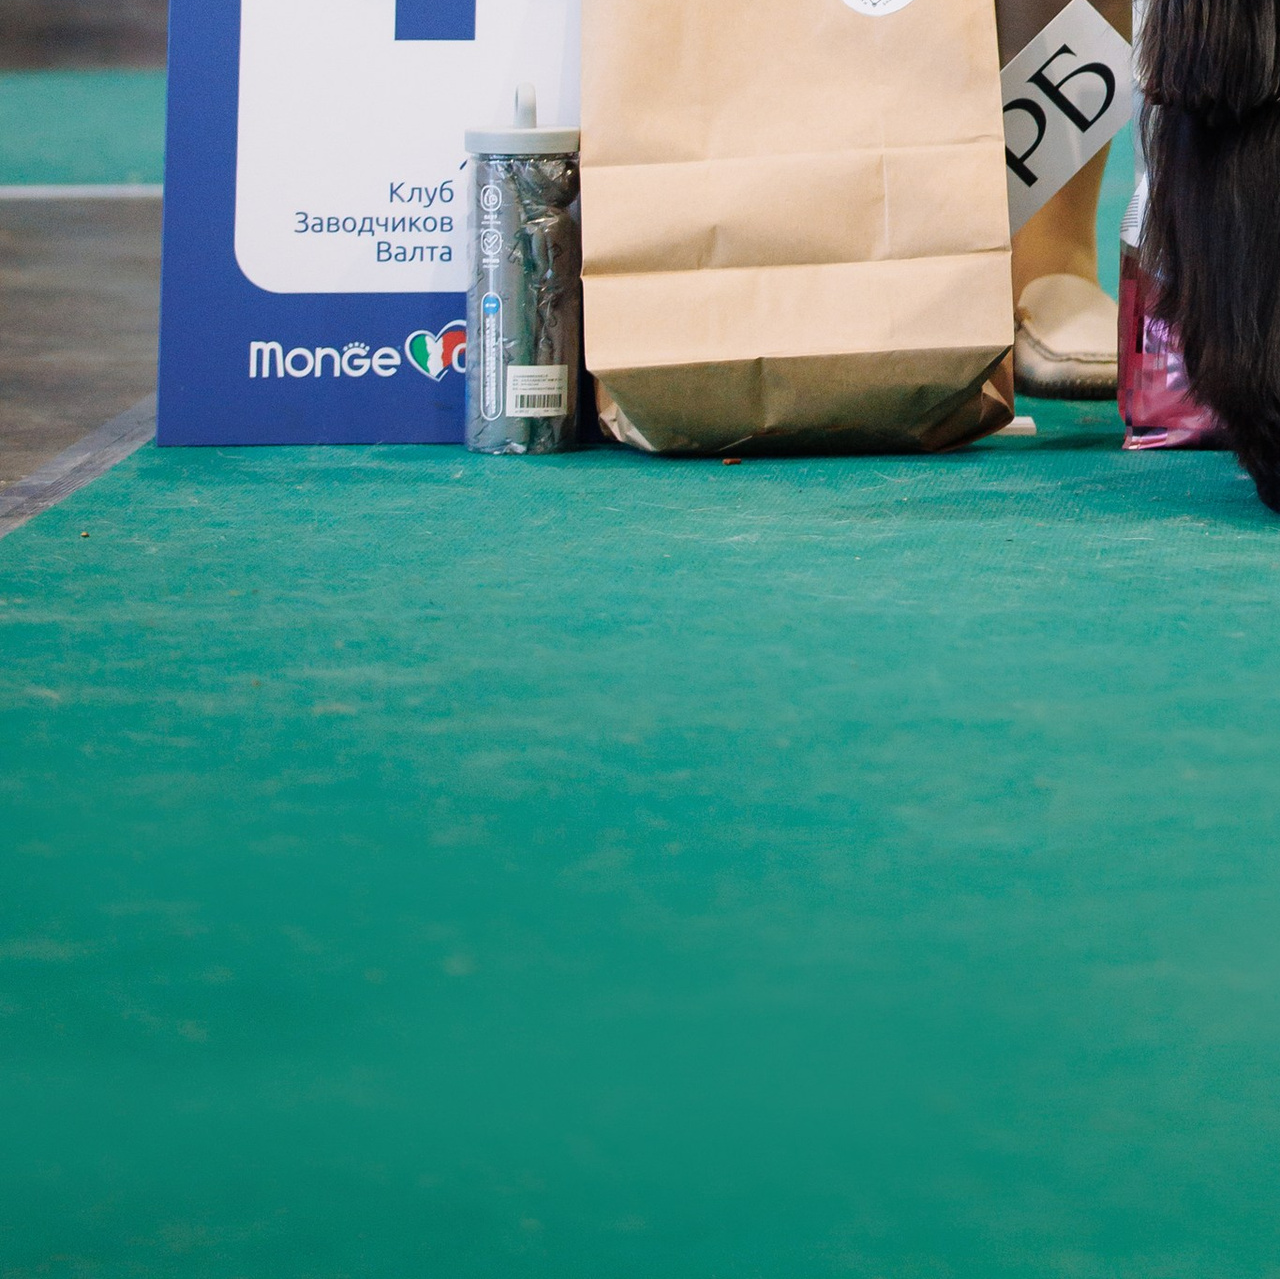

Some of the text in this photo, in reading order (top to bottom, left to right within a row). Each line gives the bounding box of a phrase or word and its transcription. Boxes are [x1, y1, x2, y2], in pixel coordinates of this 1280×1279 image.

[389, 180, 454, 208] Клуб
[294, 211, 454, 237] Заводчиков
[376, 240, 452, 262] Валта
